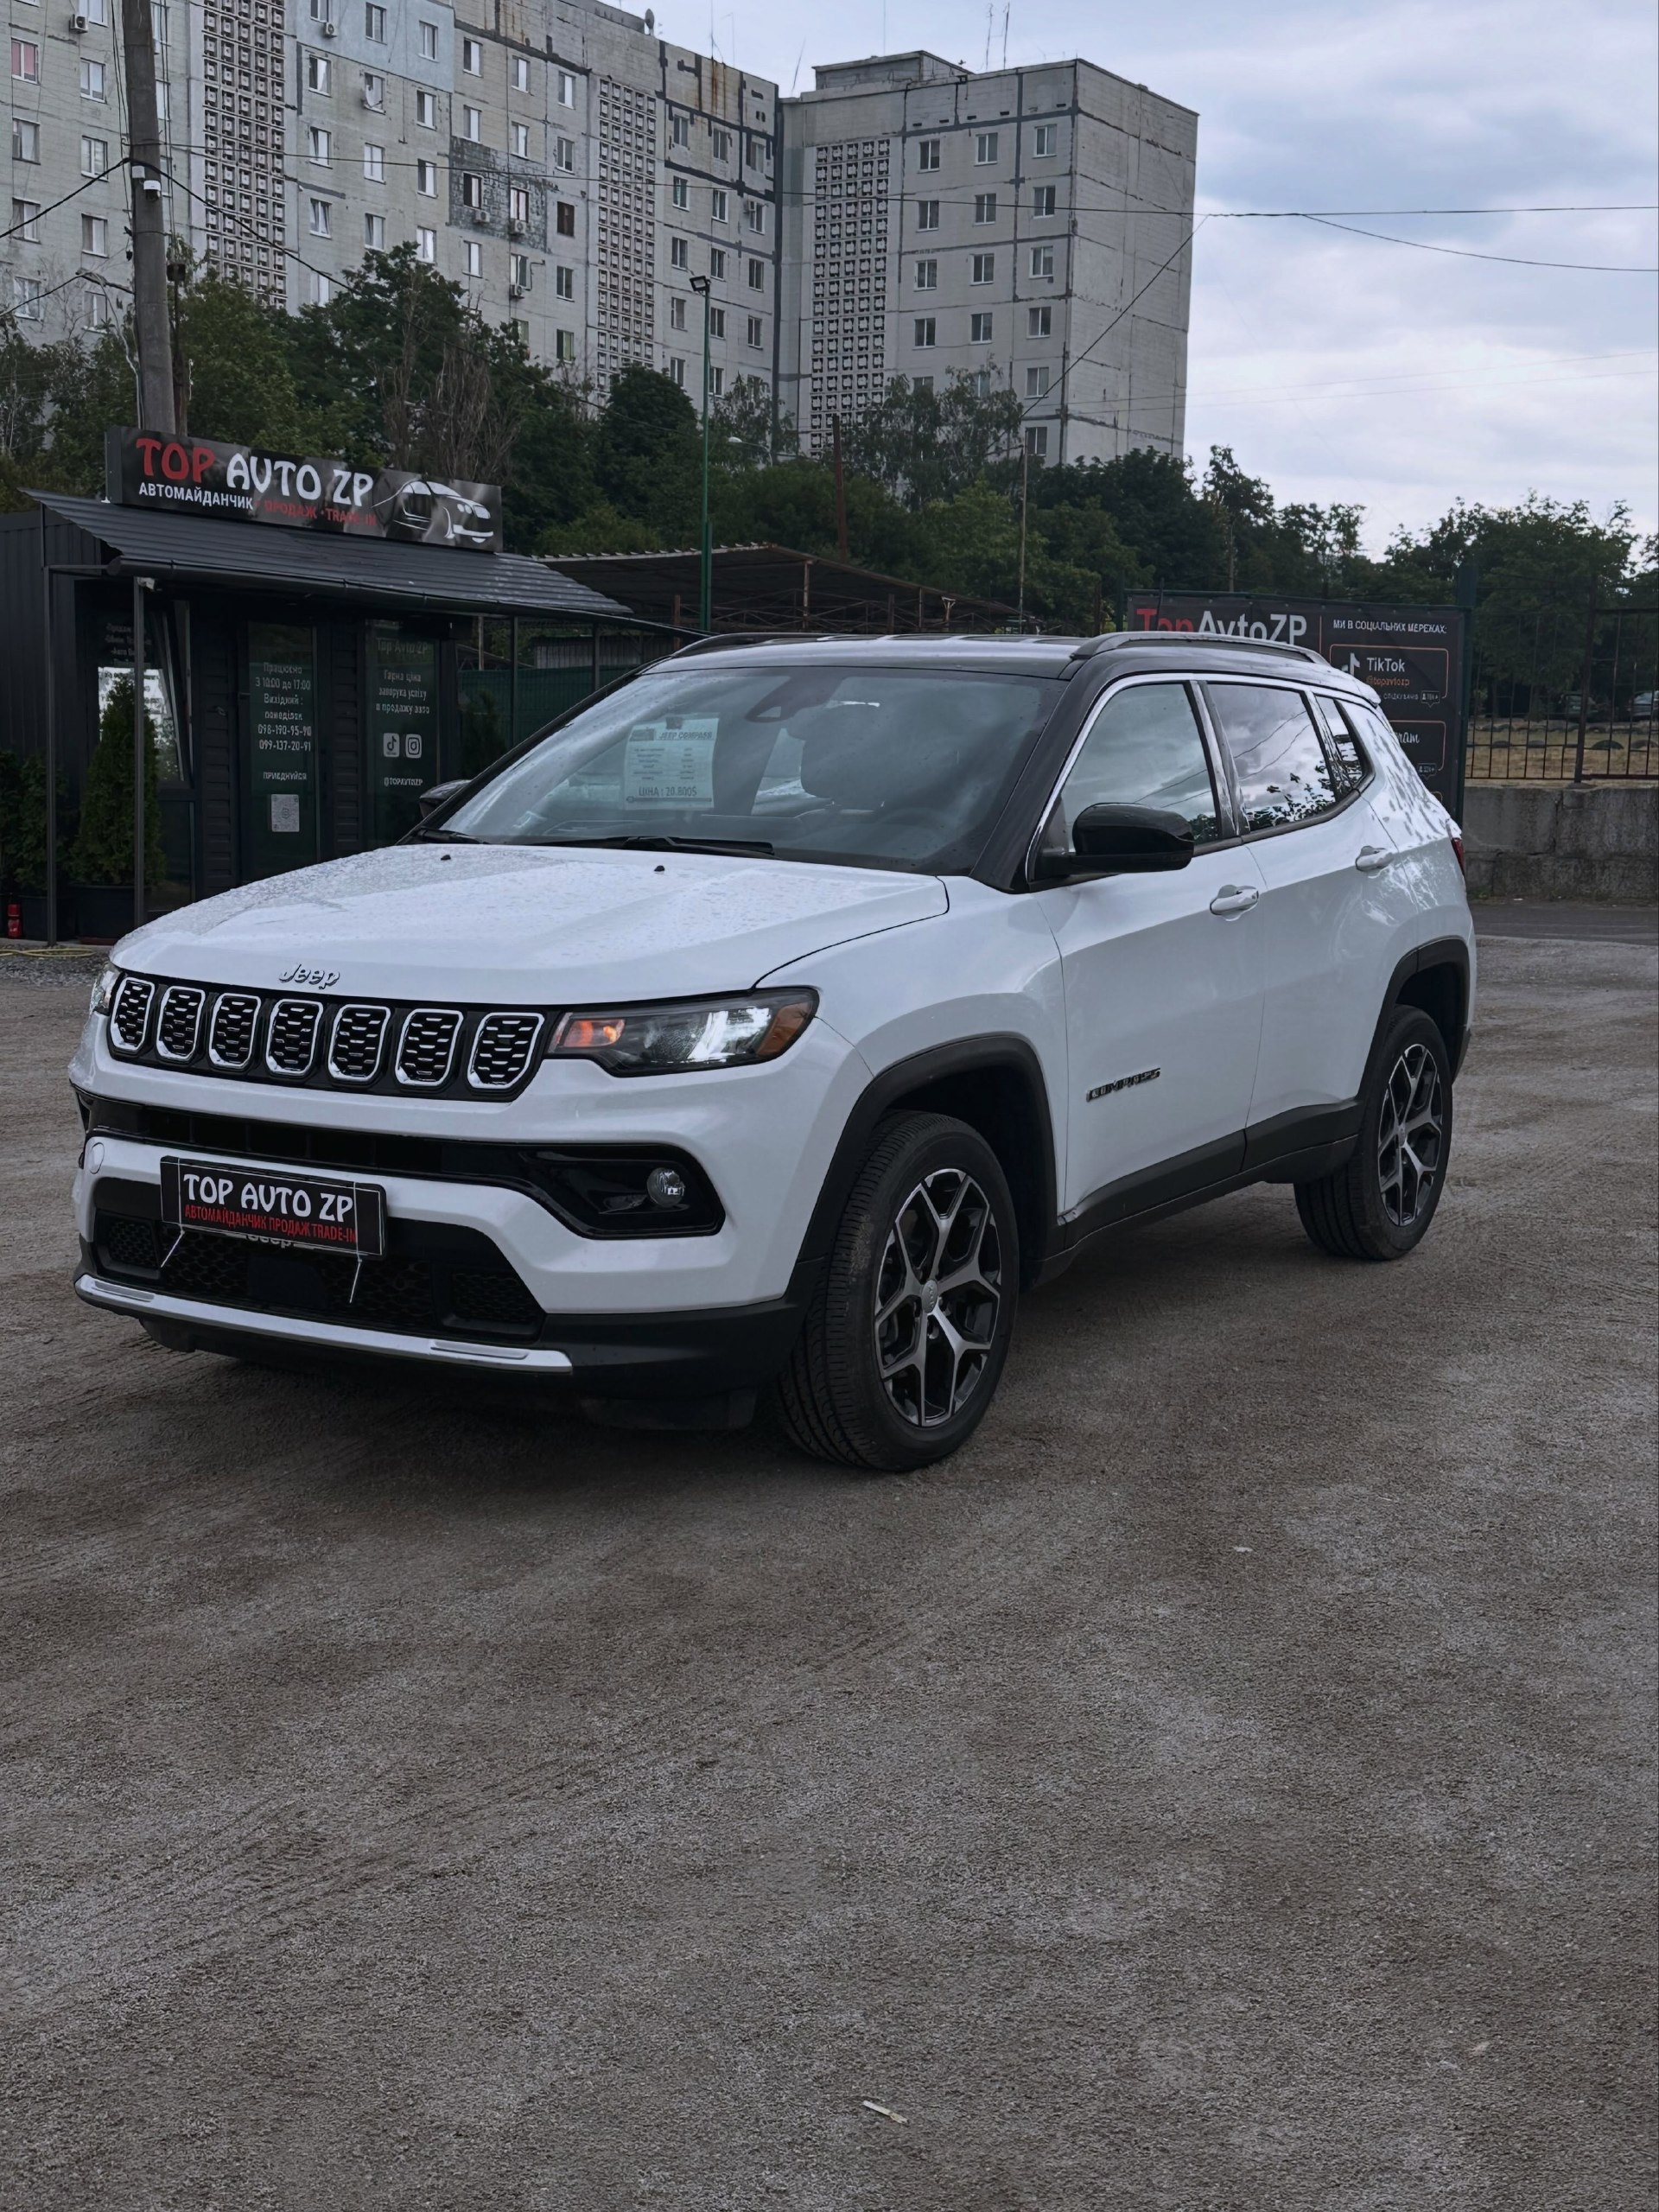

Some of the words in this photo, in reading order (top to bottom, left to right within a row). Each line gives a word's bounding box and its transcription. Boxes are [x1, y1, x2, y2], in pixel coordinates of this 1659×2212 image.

[136, 438, 215, 484] TOP
[332, 468, 374, 506] ZP
[138, 482, 254, 511] АВТОМАЙДАНЧИК
[264, 500, 318, 519] ПРОДАЖ
[1333, 620, 1345, 629] МИ
[1347, 620, 1354, 629] В
[1355, 620, 1407, 632] СОЦІАЛЬНИХ
[1366, 658, 1406, 672] TikTok
[282, 681, 292, 690] до
[639, 786, 660, 797] ЦІНА
[278, 963, 341, 990] Jeep
[183, 1173, 233, 1205] TOP
[319, 1192, 354, 1224] ZP
[185, 1204, 267, 1230] АВТОМАЙДАНЧИК
[269, 1217, 310, 1237] ПРОДАЖ
